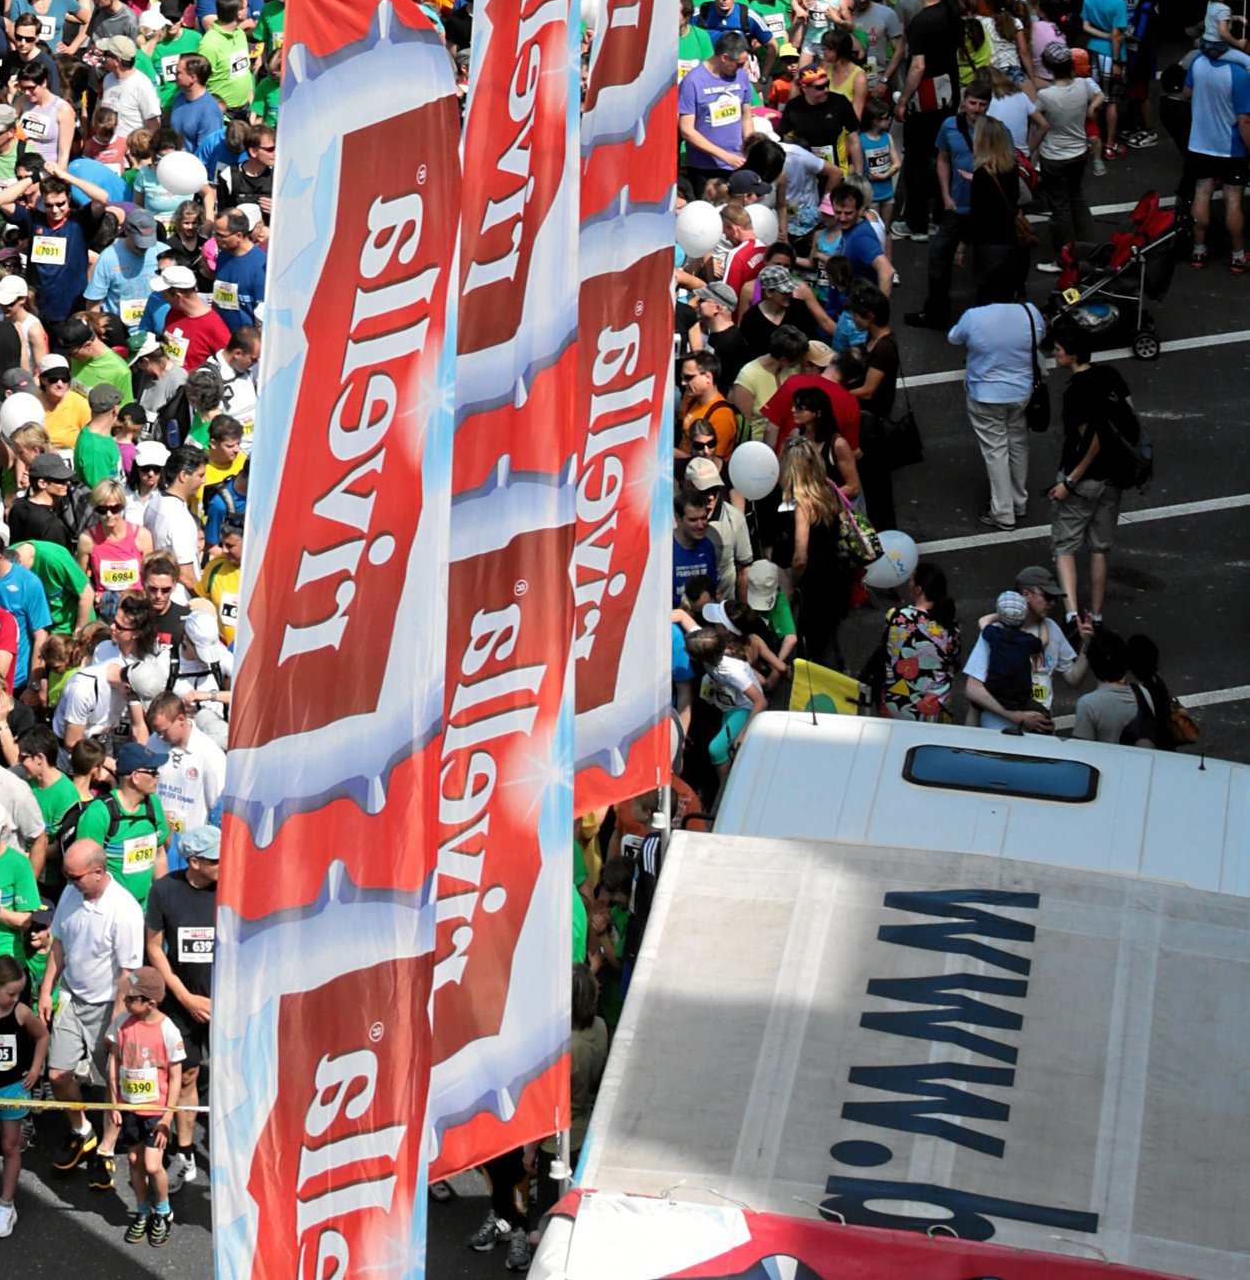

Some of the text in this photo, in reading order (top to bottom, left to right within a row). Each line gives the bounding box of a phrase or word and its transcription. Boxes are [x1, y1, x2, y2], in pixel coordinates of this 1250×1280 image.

[40, 247, 59, 257] 7031
[111, 572, 132, 582] 6984
[134, 849, 154, 862] 6787
[127, 1081, 152, 1093] 6390
